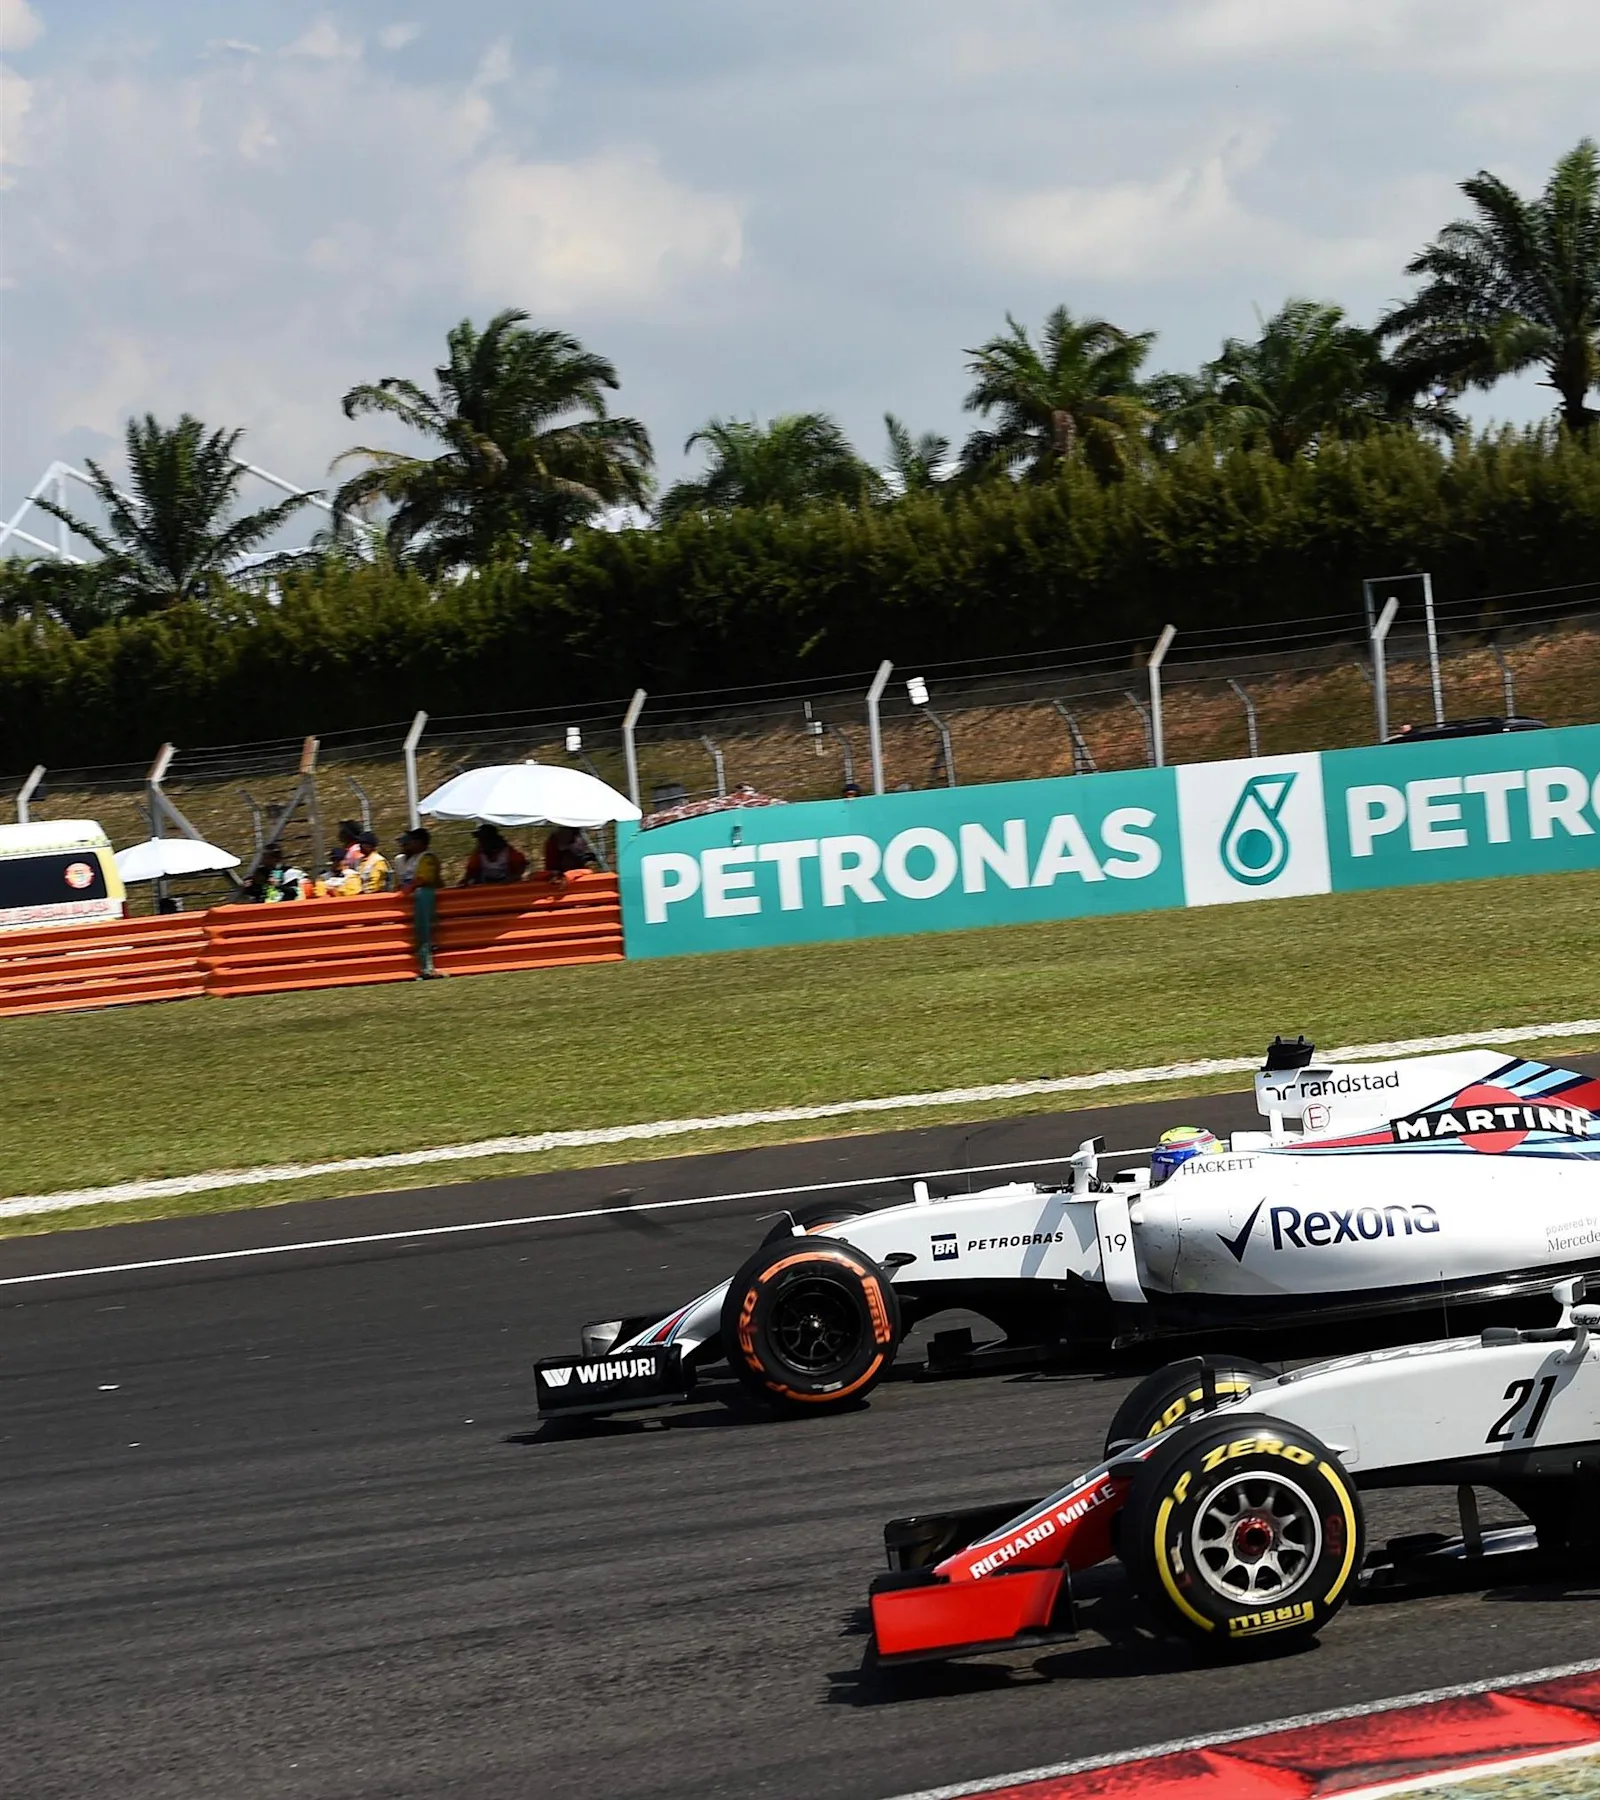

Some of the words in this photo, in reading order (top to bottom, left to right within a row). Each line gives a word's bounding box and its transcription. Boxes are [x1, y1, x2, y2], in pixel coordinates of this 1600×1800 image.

[641, 807, 1162, 924] PETRONAS
[1300, 1071, 1399, 1097] randstad
[1308, 1106, 1324, 1130] E
[1183, 1157, 1259, 1175] HACKETT
[1270, 1204, 1440, 1251] Rexona
[1545, 1218, 1584, 1237] powered
[1586, 1216, 1597, 1227] by
[967, 1231, 1064, 1251] PETROBRAS
[1105, 1233, 1127, 1253] 19
[575, 1357, 656, 1384] WIHURI
[1485, 1375, 1558, 1443] 21
[1173, 1470, 1193, 1504] P
[1201, 1438, 1316, 1473] ZERO
[969, 1520, 1056, 1580] RICHARD
[1056, 1483, 1116, 1527] MILLE
[1229, 1601, 1316, 1638] PIRELLI
